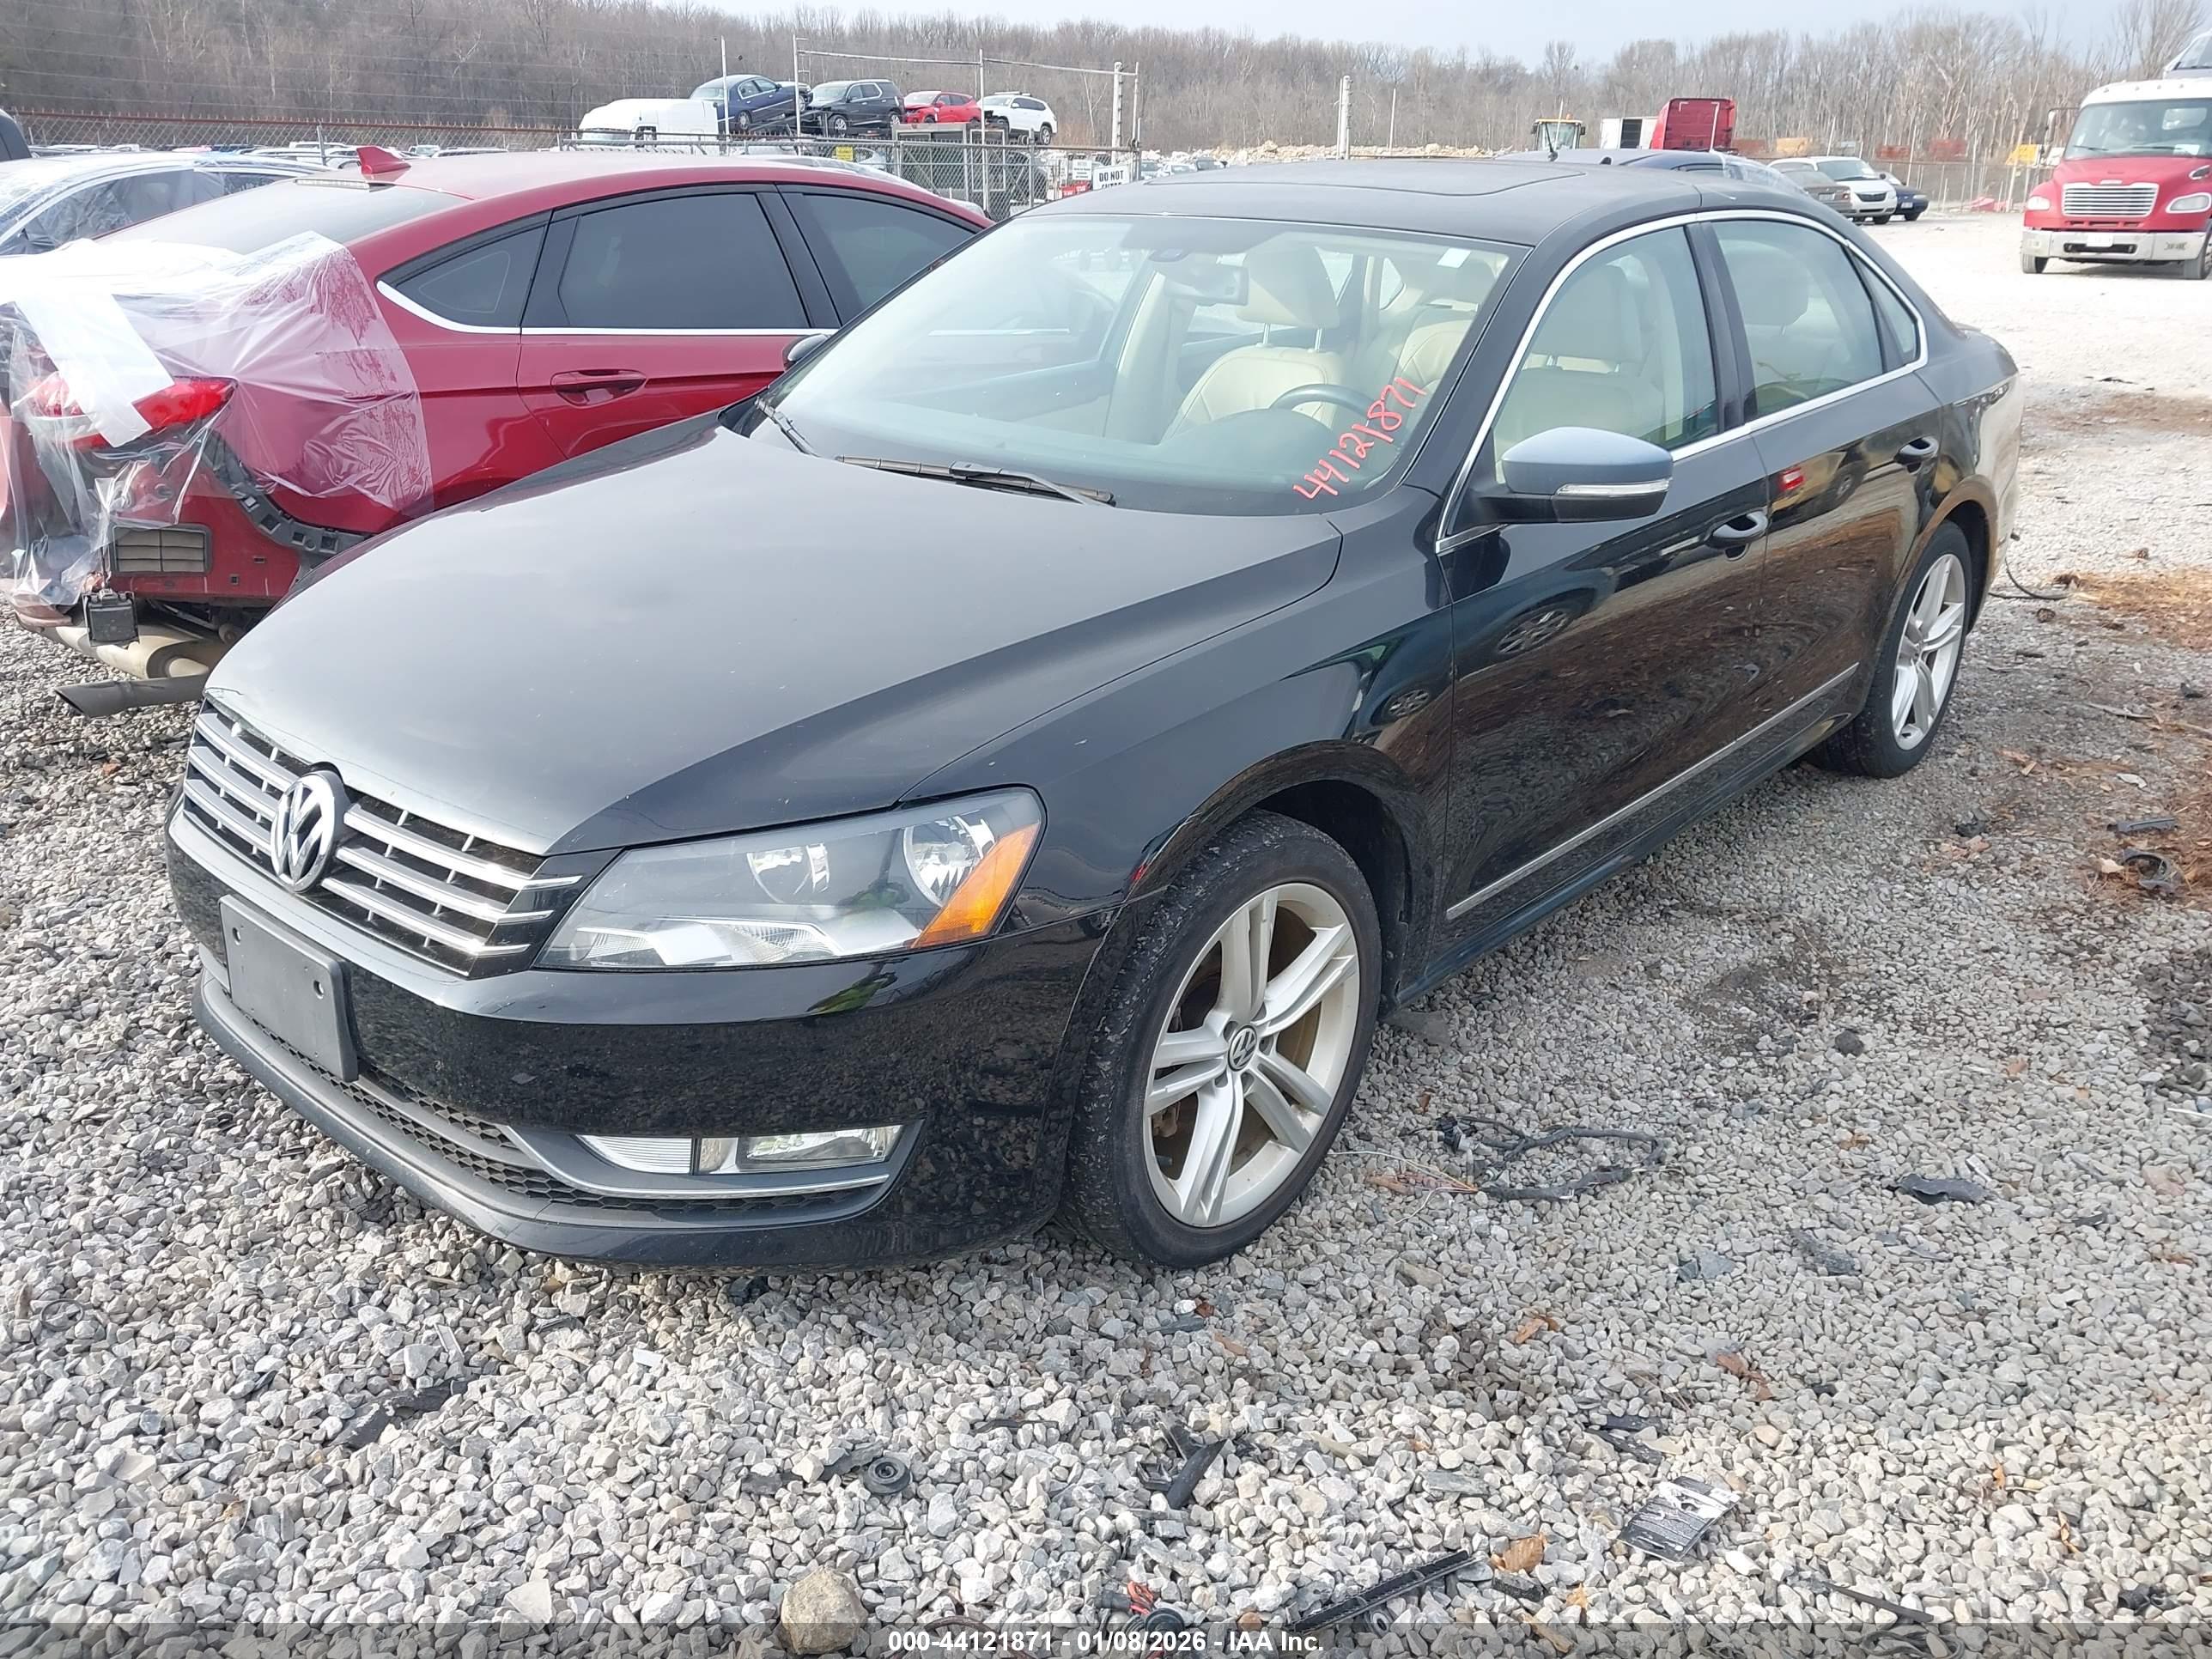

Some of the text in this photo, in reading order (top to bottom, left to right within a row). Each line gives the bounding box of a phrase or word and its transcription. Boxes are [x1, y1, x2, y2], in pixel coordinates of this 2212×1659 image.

[1099, 170, 1124, 183] DO NOT
[1292, 377, 1427, 499] 44121871
